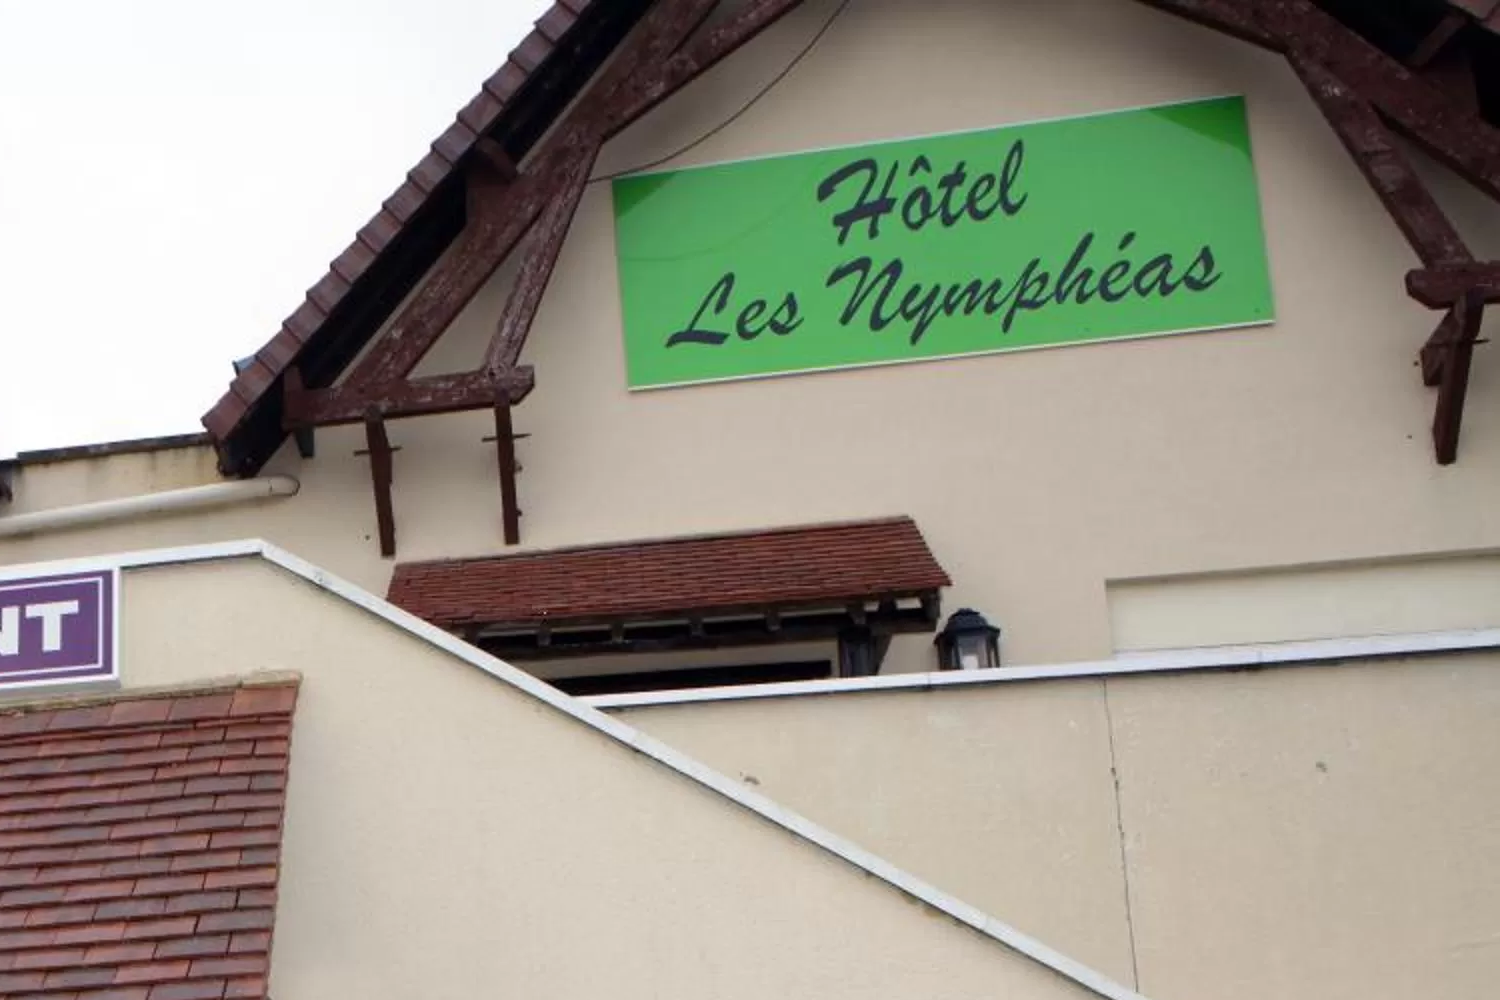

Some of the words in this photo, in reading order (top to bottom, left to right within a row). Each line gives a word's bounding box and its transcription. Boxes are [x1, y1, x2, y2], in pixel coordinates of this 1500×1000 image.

[817, 139, 1028, 245] Hôtel
[665, 272, 805, 349] Les
[826, 231, 1222, 346] Nymphéas
